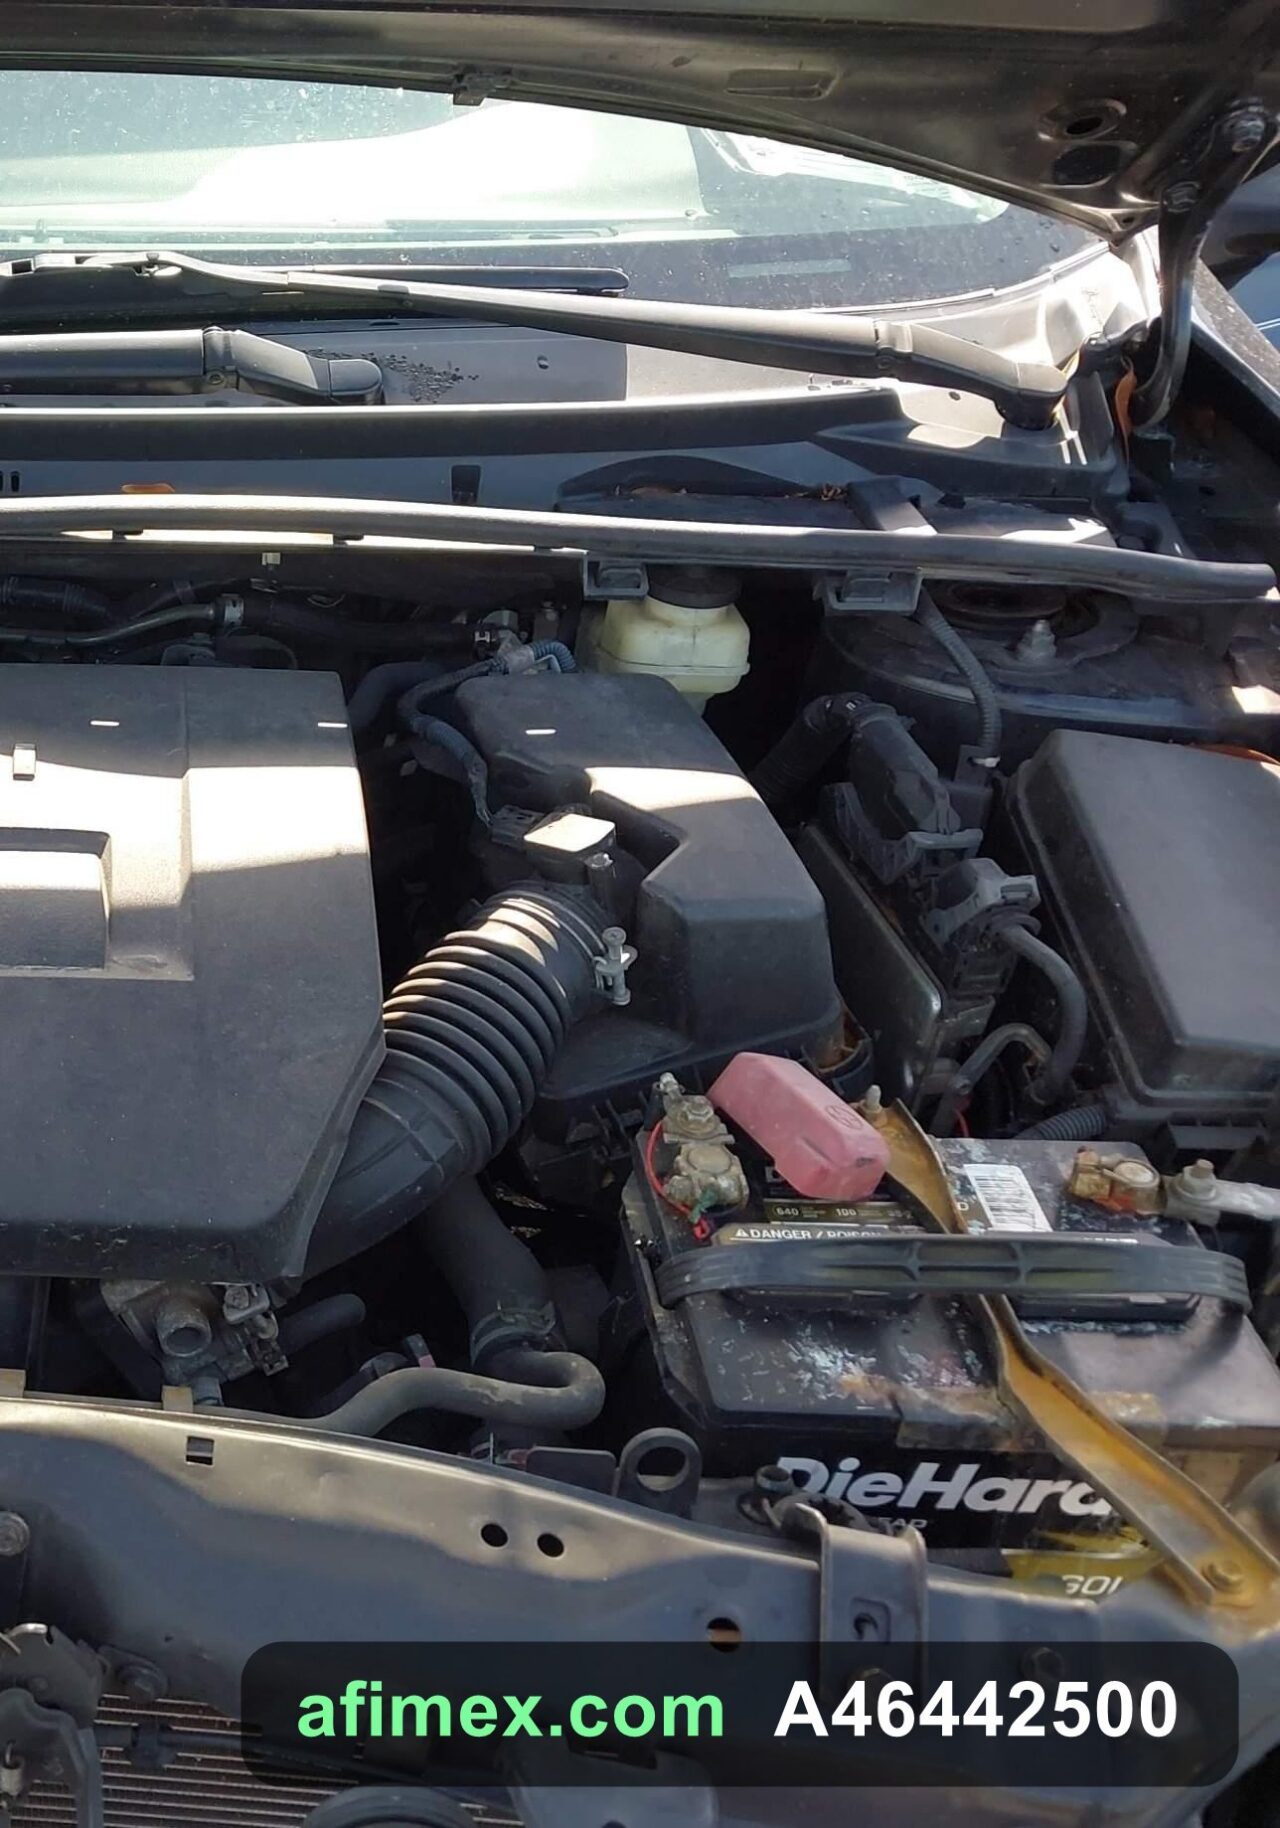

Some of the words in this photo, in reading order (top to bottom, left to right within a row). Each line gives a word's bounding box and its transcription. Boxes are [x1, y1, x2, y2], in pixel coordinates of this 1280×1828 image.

[776, 1207, 799, 1216] 640
[836, 1208, 856, 1217] 100
[749, 1228, 812, 1240] DANGER
